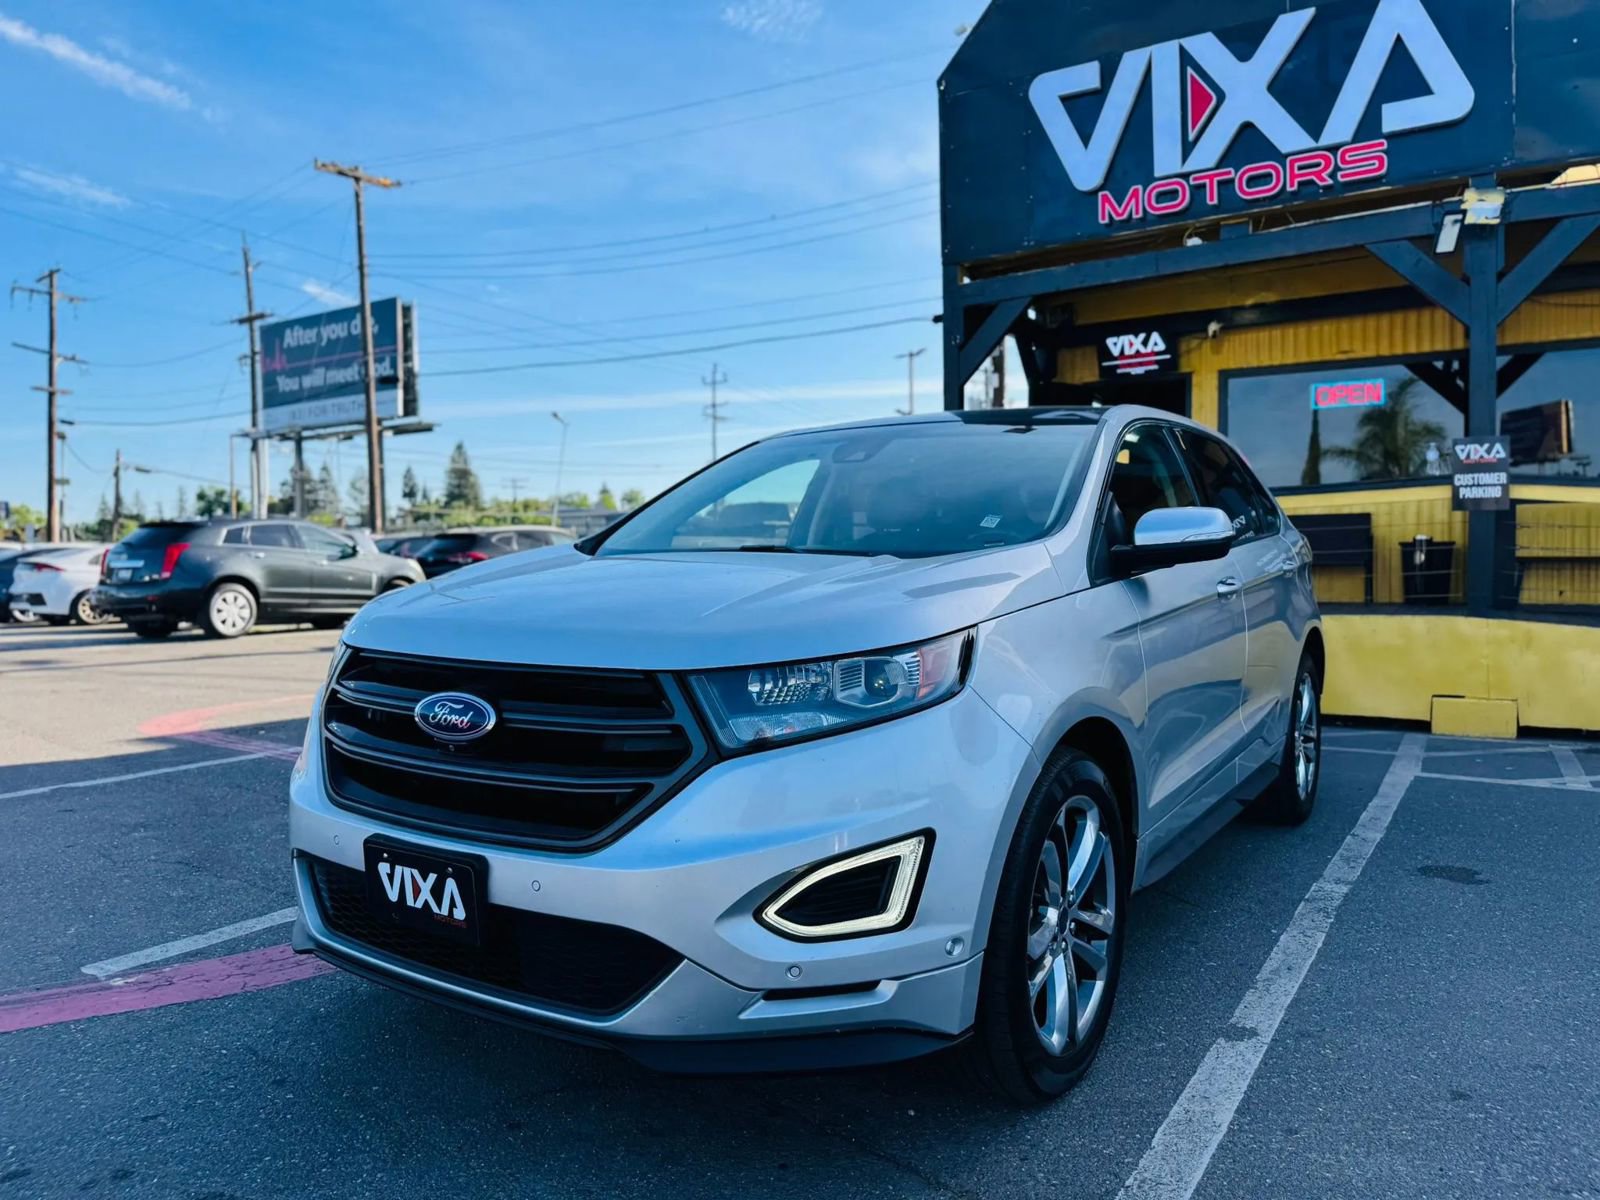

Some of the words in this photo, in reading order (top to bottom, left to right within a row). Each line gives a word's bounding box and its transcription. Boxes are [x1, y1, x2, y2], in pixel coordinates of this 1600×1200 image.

[1028, 0, 1475, 192] VIXA
[1098, 139, 1388, 224] MOTORS
[283, 324, 318, 348] After
[320, 319, 347, 346] you
[1105, 331, 1166, 357] VIXA
[276, 374, 299, 392] You
[302, 367, 325, 389] will
[326, 363, 360, 384] meet
[361, 357, 394, 379] od.
[1316, 383, 1382, 407] OPEN
[1454, 442, 1506, 460] VIXA
[1454, 471, 1507, 486] CUSTOMER
[1459, 486, 1502, 499] PARKING
[429, 701, 474, 729] Ford
[378, 862, 466, 920] VIXA
